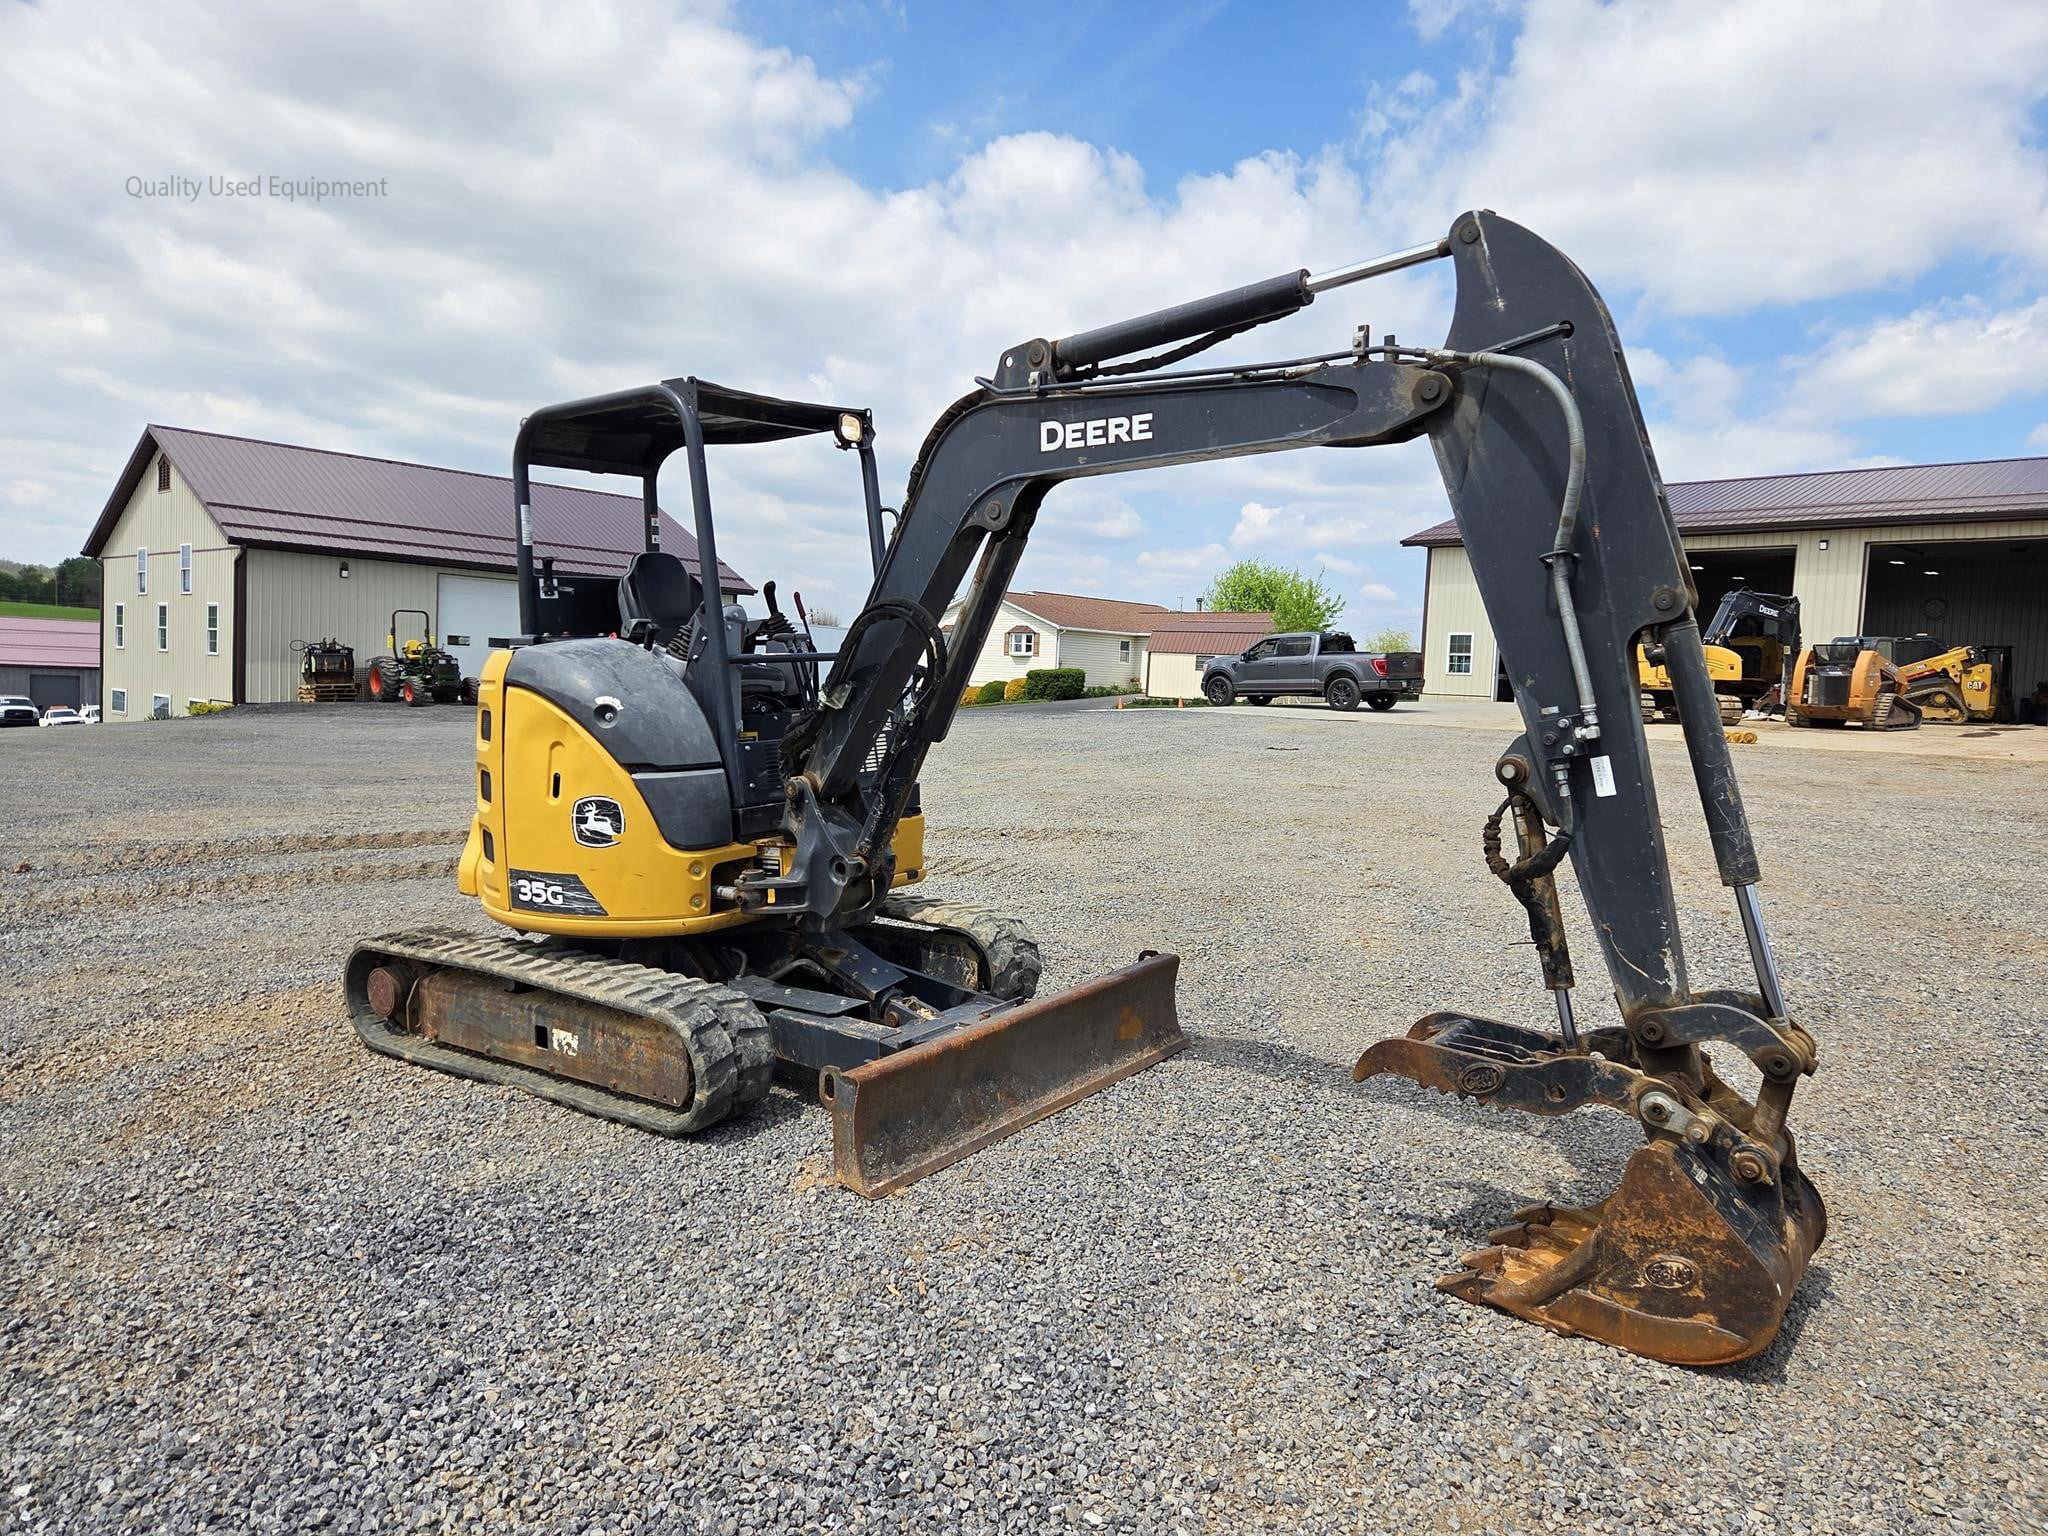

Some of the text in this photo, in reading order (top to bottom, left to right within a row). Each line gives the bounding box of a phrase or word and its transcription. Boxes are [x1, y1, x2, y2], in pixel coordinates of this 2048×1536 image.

[1040, 412, 1153, 452] DEERE
[1967, 681, 1983, 690] CAT
[517, 879, 564, 905] 35G
